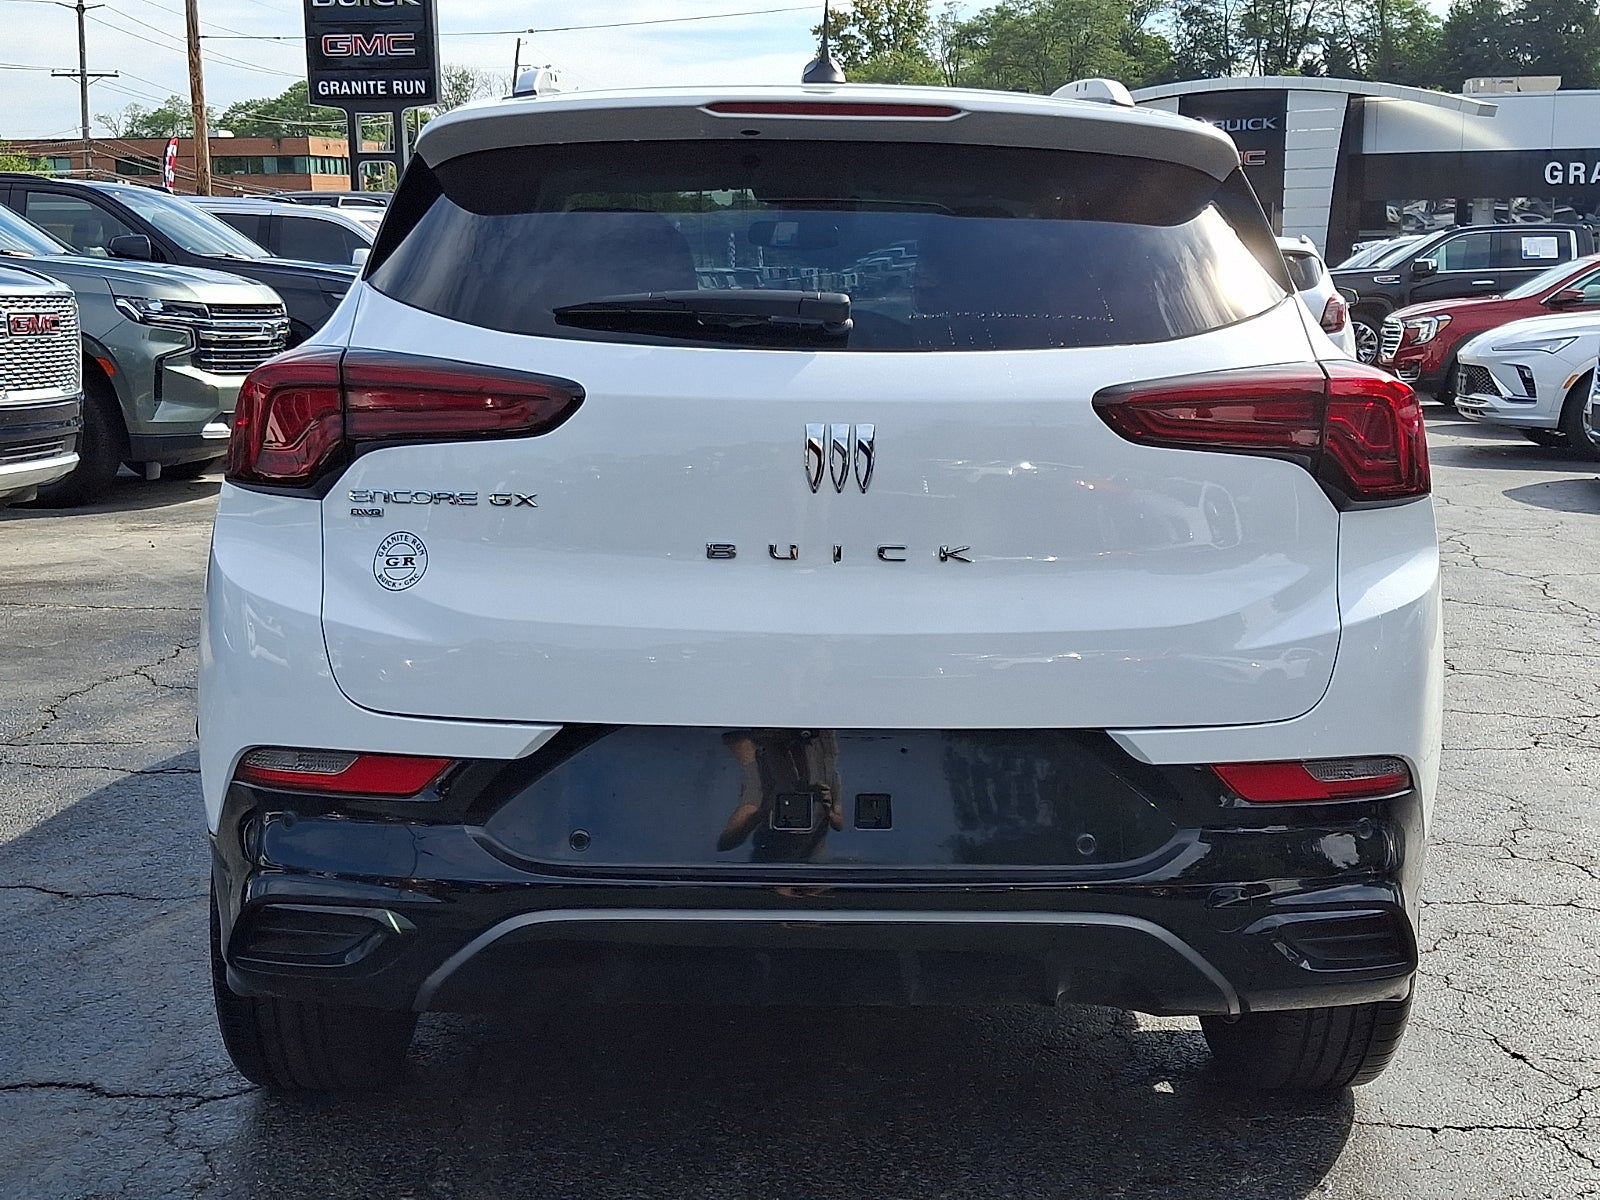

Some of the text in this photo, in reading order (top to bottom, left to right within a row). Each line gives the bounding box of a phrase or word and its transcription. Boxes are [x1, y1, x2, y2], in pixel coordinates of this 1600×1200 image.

[322, 33, 416, 57] GMC
[318, 80, 426, 95] GRANITE RUN
[10, 314, 60, 334] GMC
[348, 489, 538, 507] ENCORE GX
[378, 534, 425, 558] GRANITE RUN
[706, 543, 974, 562] BUICK
[377, 573, 420, 588] BUICK GMC
